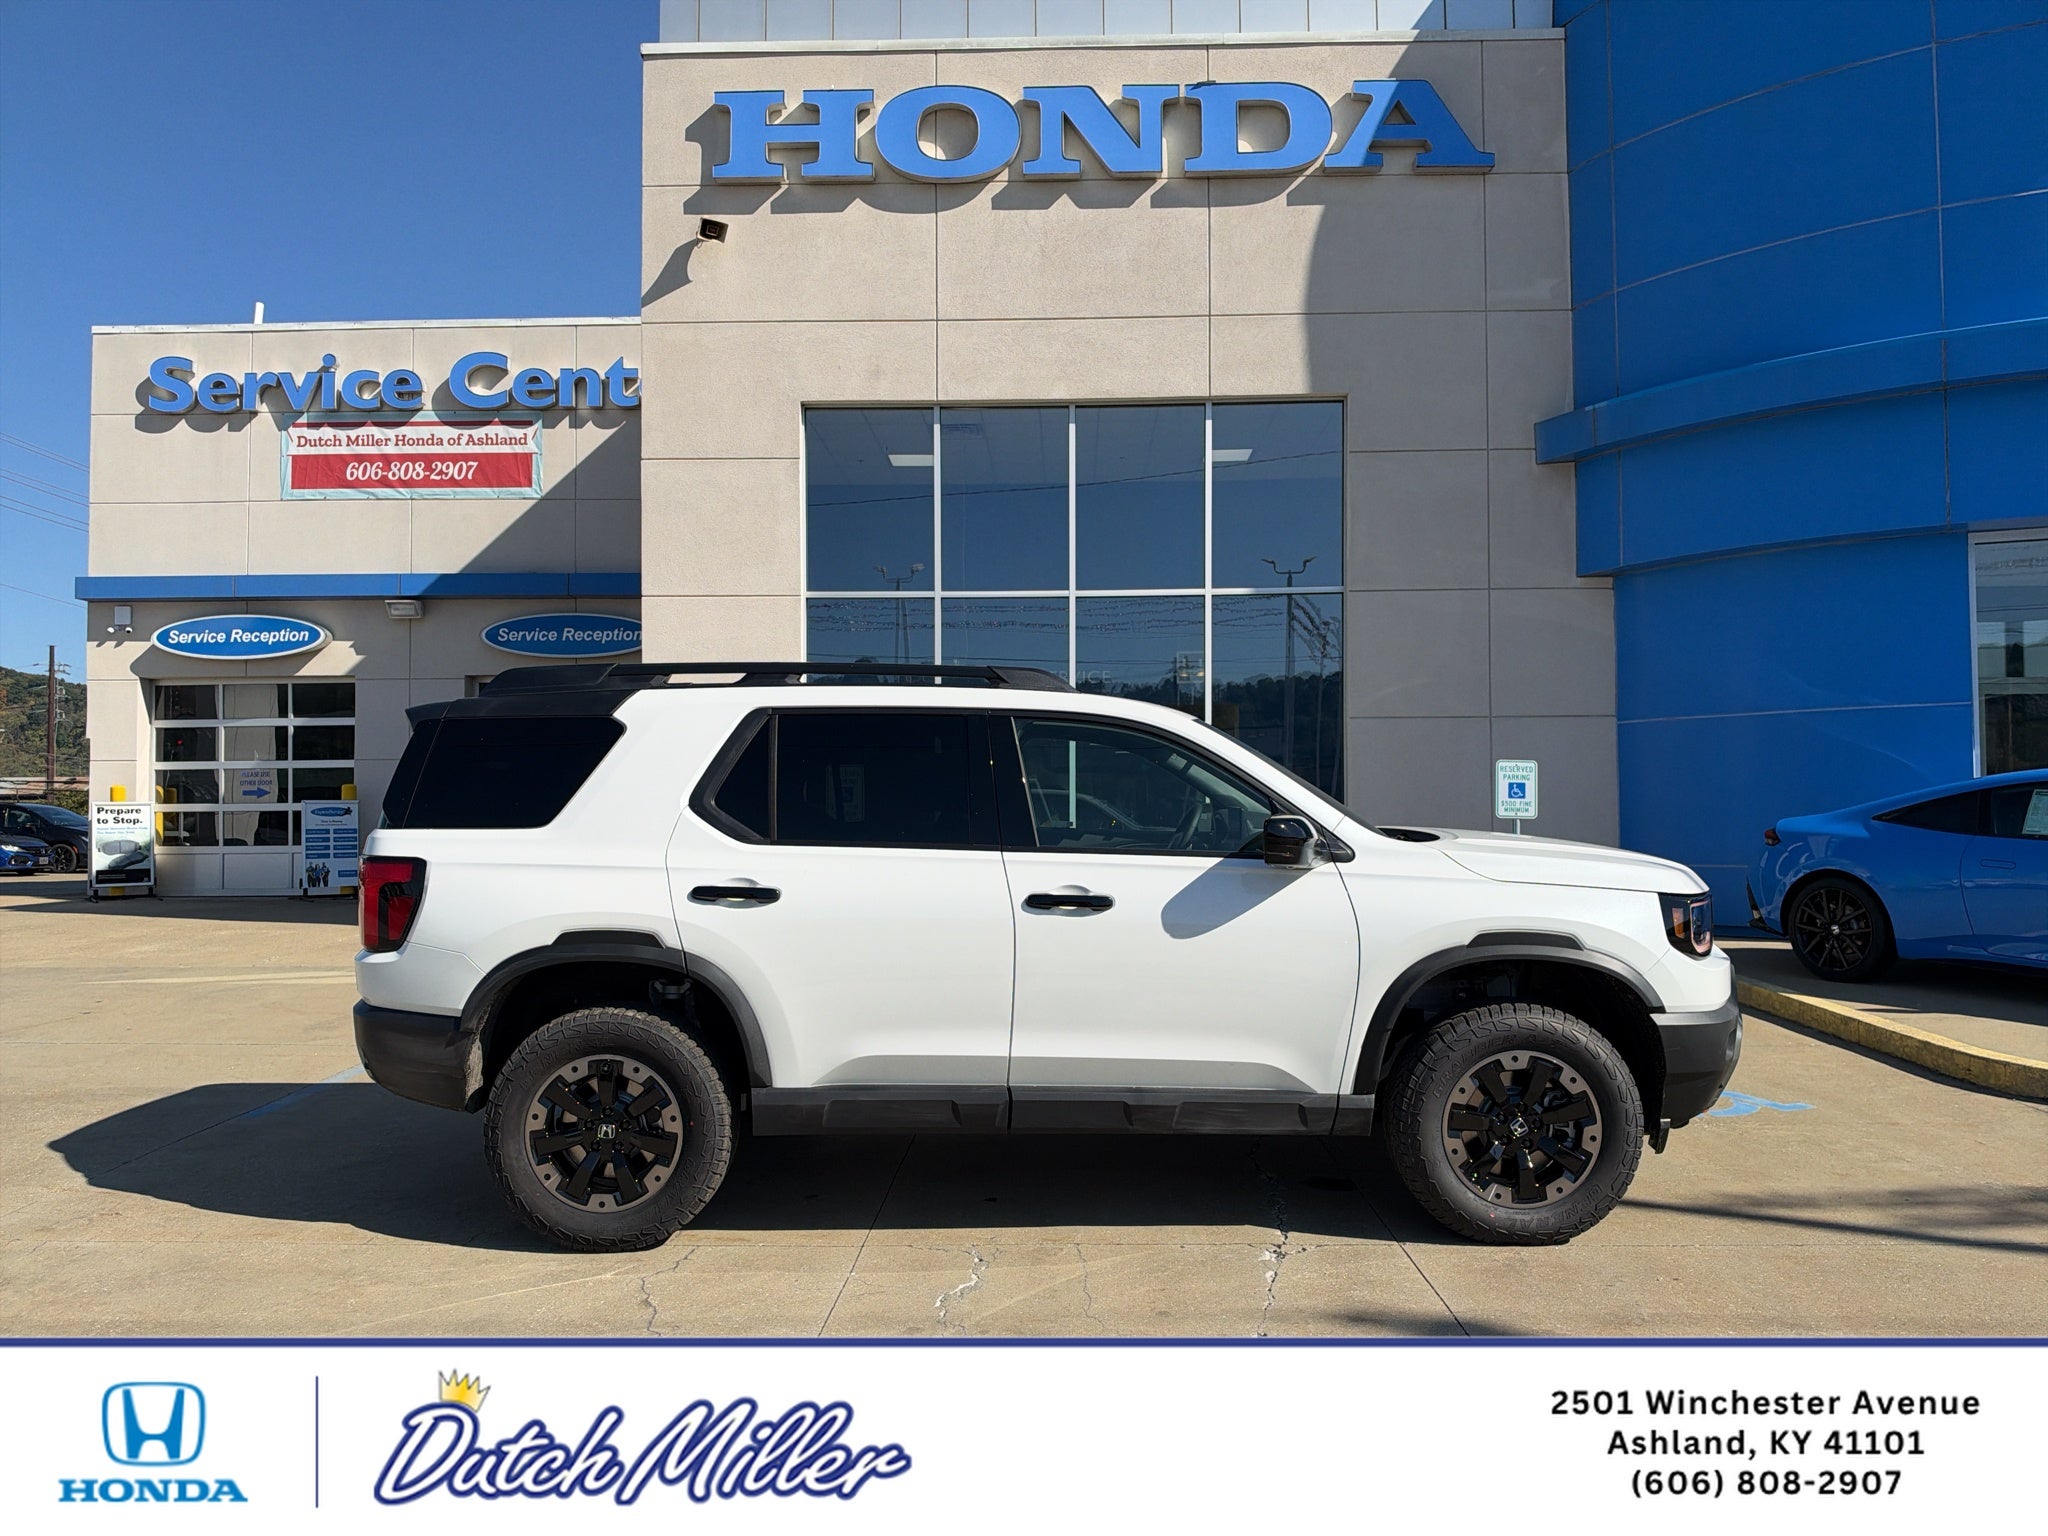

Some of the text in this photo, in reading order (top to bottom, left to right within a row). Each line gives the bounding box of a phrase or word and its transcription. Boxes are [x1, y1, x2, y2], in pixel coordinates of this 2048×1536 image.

[712, 78, 1496, 183] HONDA
[148, 351, 642, 414] Service Cent
[296, 433, 528, 448] Dutch Miller Honda of Ashland
[345, 461, 479, 481] 606-808-2907
[168, 628, 309, 645] Service Reception
[497, 627, 558, 642] Service
[1500, 765, 1534, 773] RESERVED
[96, 806, 142, 816] Prepare
[112, 816, 143, 826] Stop.
